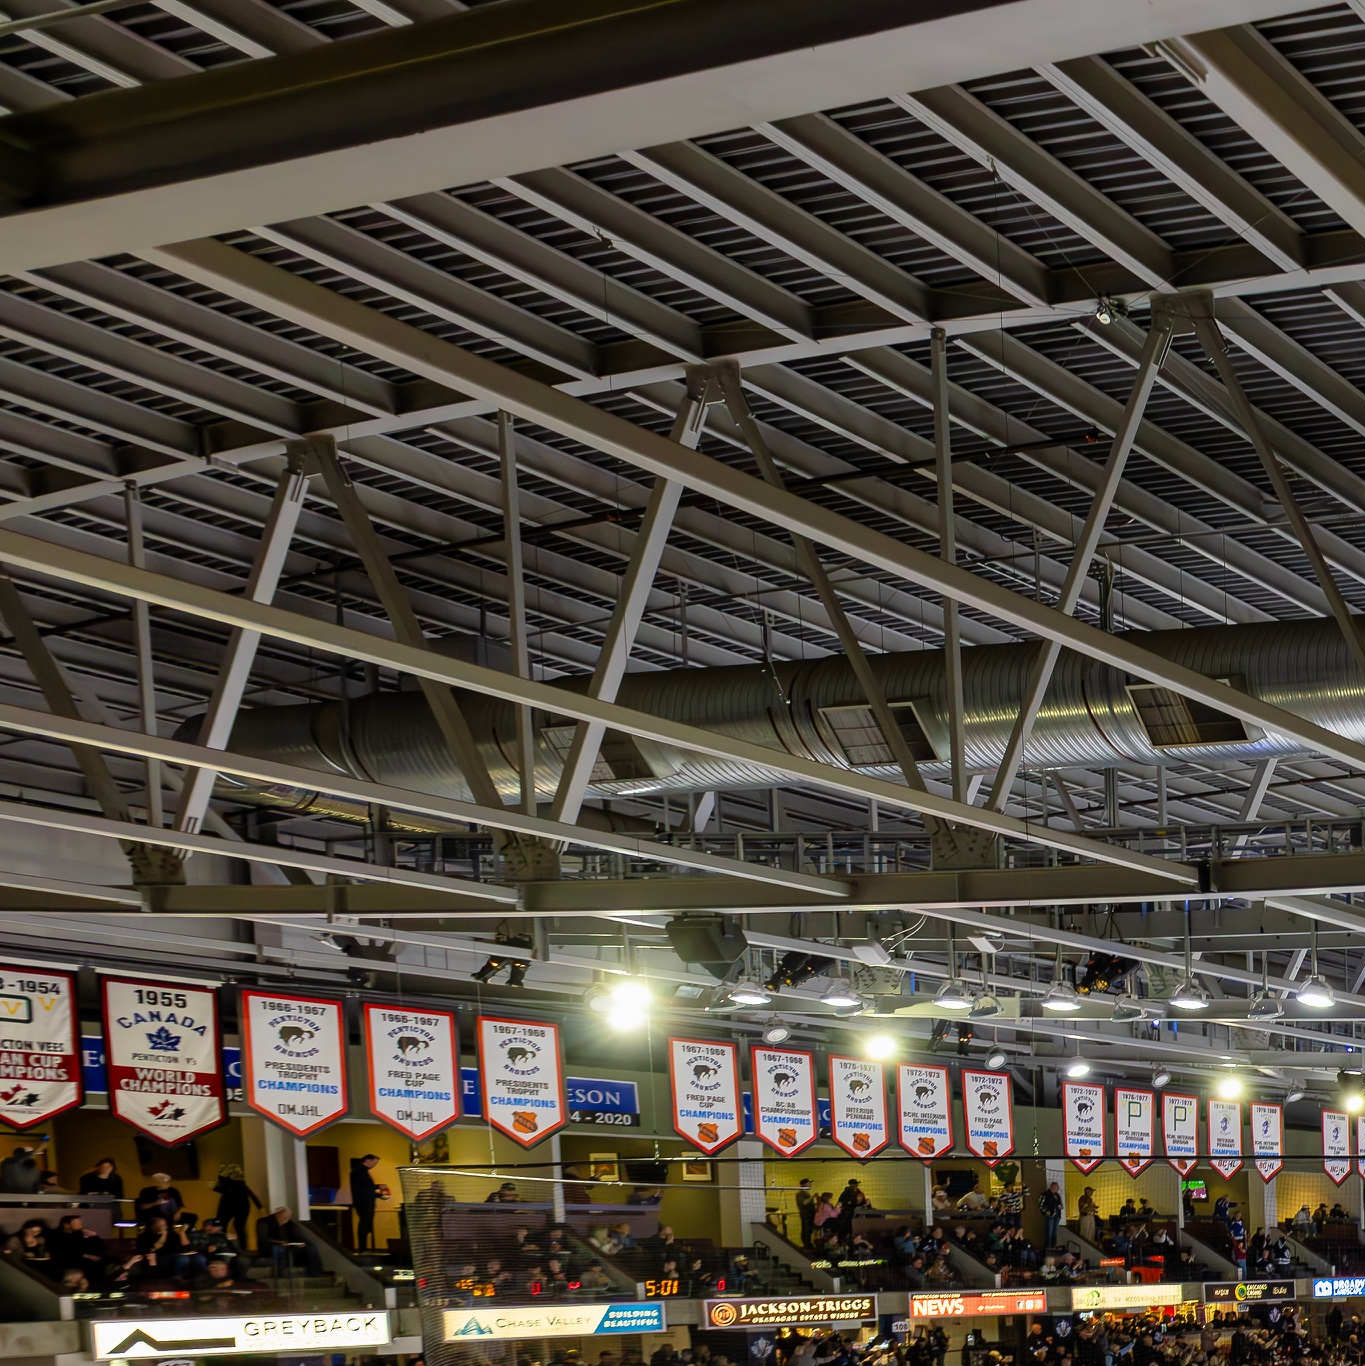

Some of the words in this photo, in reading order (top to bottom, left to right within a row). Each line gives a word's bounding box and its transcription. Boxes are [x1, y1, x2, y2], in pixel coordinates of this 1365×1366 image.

[134, 989, 187, 1008] 1955
[116, 1010, 207, 1036] CANADA
[268, 1015, 322, 1032] PENTICTON
[387, 1026, 436, 1042] PENTICTON
[38, 1041, 64, 1052] VEES
[273, 1044, 320, 1058] BRONCOS
[499, 1037, 541, 1053] PENTICTON
[29, 1055, 62, 1067] CUP
[132, 1052, 179, 1063] PENTICTON
[392, 1054, 434, 1067] BRONCOS
[264, 1061, 331, 1074] PRESIDENTS
[502, 1064, 541, 1076] BRONCOS
[135, 1068, 196, 1083] WORLD
[277, 1070, 318, 1081] TROPHY
[388, 1070, 413, 1080] FRED
[415, 1072, 441, 1082] PAGE
[120, 1078, 211, 1096] CHAMPIONS
[258, 1079, 339, 1095] CHAMPIONS
[404, 1079, 425, 1088] CUP
[495, 1079, 549, 1090] PRESIDENTS
[378, 1087, 451, 1102] CHAMPIONS
[506, 1087, 540, 1096] TROPHY
[490, 1096, 557, 1109] CHAMPIONS
[686, 1094, 705, 1103] FRED
[707, 1096, 726, 1104] PAGE
[679, 1109, 734, 1120] CHAMPIONS
[760, 1106, 811, 1116] CHAMPIONSHIP
[595, 1112, 632, 1125] 2020
[762, 1115, 811, 1126] CHAMPIONS
[837, 1121, 883, 1131] CHAMPIONS
[903, 1125, 947, 1135] CHAMPIONS
[970, 1129, 1009, 1139] CHAMPIONS
[646, 1280, 679, 1296] 5:01
[740, 1299, 871, 1318] JACKSON-TRIGGS
[913, 1298, 965, 1316] NEWS
[608, 1309, 659, 1320] BUILDING
[752, 1316, 797, 1324] OKANAGAN
[800, 1313, 829, 1322] ESTATE
[830, 1312, 859, 1320] WINERY
[244, 1317, 378, 1337] GREYBACK
[604, 1318, 660, 1329] BEAUTIFUL
[894, 1323, 908, 1331] 108
